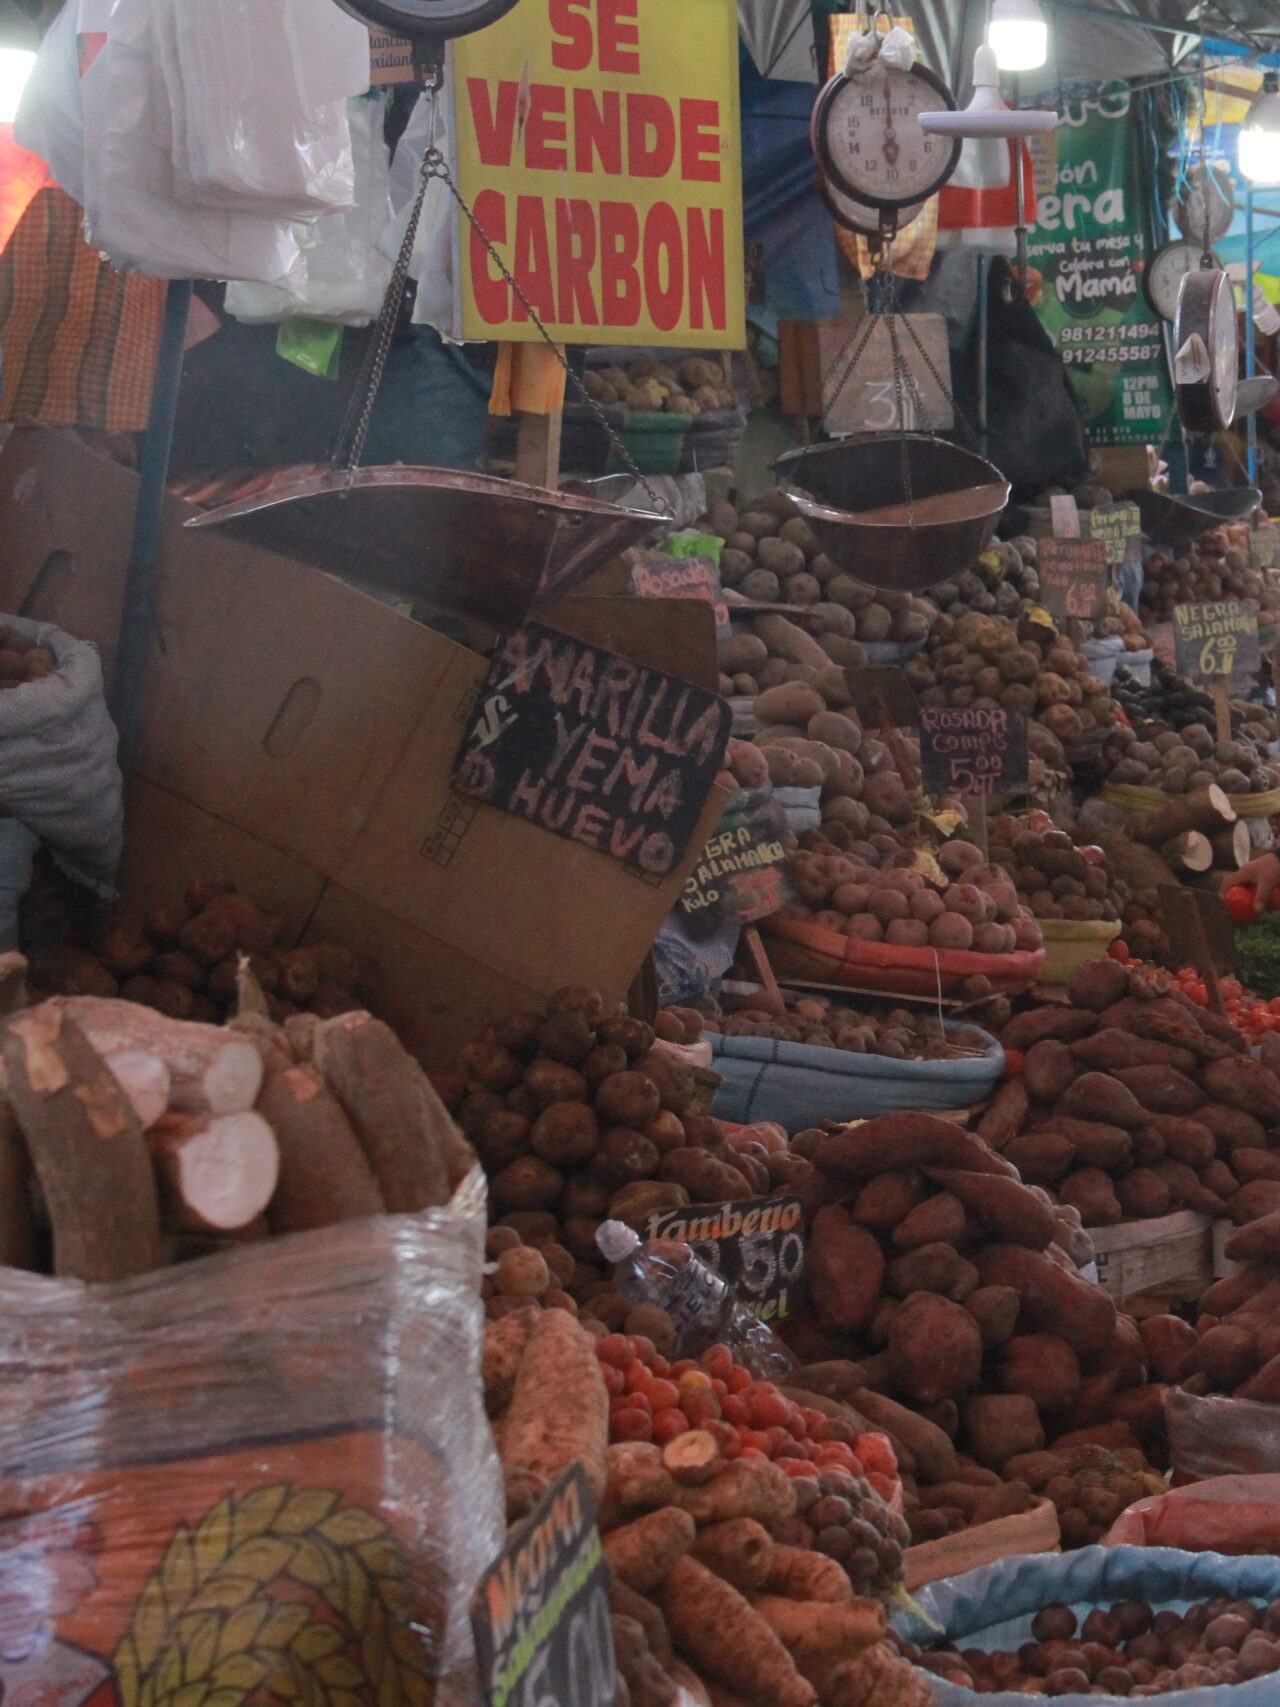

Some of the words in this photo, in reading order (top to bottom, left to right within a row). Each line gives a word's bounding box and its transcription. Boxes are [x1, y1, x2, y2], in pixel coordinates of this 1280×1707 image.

[548, 0, 640, 75] SE
[860, 95, 873, 107] 18
[908, 95, 916, 106] 2
[466, 77, 721, 183] VENDE
[847, 116, 859, 128] 16
[849, 142, 860, 154] 14
[924, 142, 932, 153] 6
[865, 160, 878, 171] 12
[886, 169, 899, 180] 10
[1071, 237, 1092, 252] tu
[1096, 236, 1130, 250] mesa
[1134, 233, 1145, 249] y
[469, 188, 727, 332] CARBON
[1059, 257, 1104, 274] Celebra
[1108, 256, 1131, 269] con
[1056, 268, 1137, 302] Mamá
[1061, 323, 1160, 342] 981211494
[1062, 344, 1162, 363] 912455587
[1123, 376, 1159, 391] 12PM
[1135, 391, 1153, 405] DE
[1124, 405, 1162, 419] MAYO
[1174, 601, 1240, 625] NEGRA
[546, 711, 682, 820] YEMA
[507, 767, 675, 874] HUEVO
